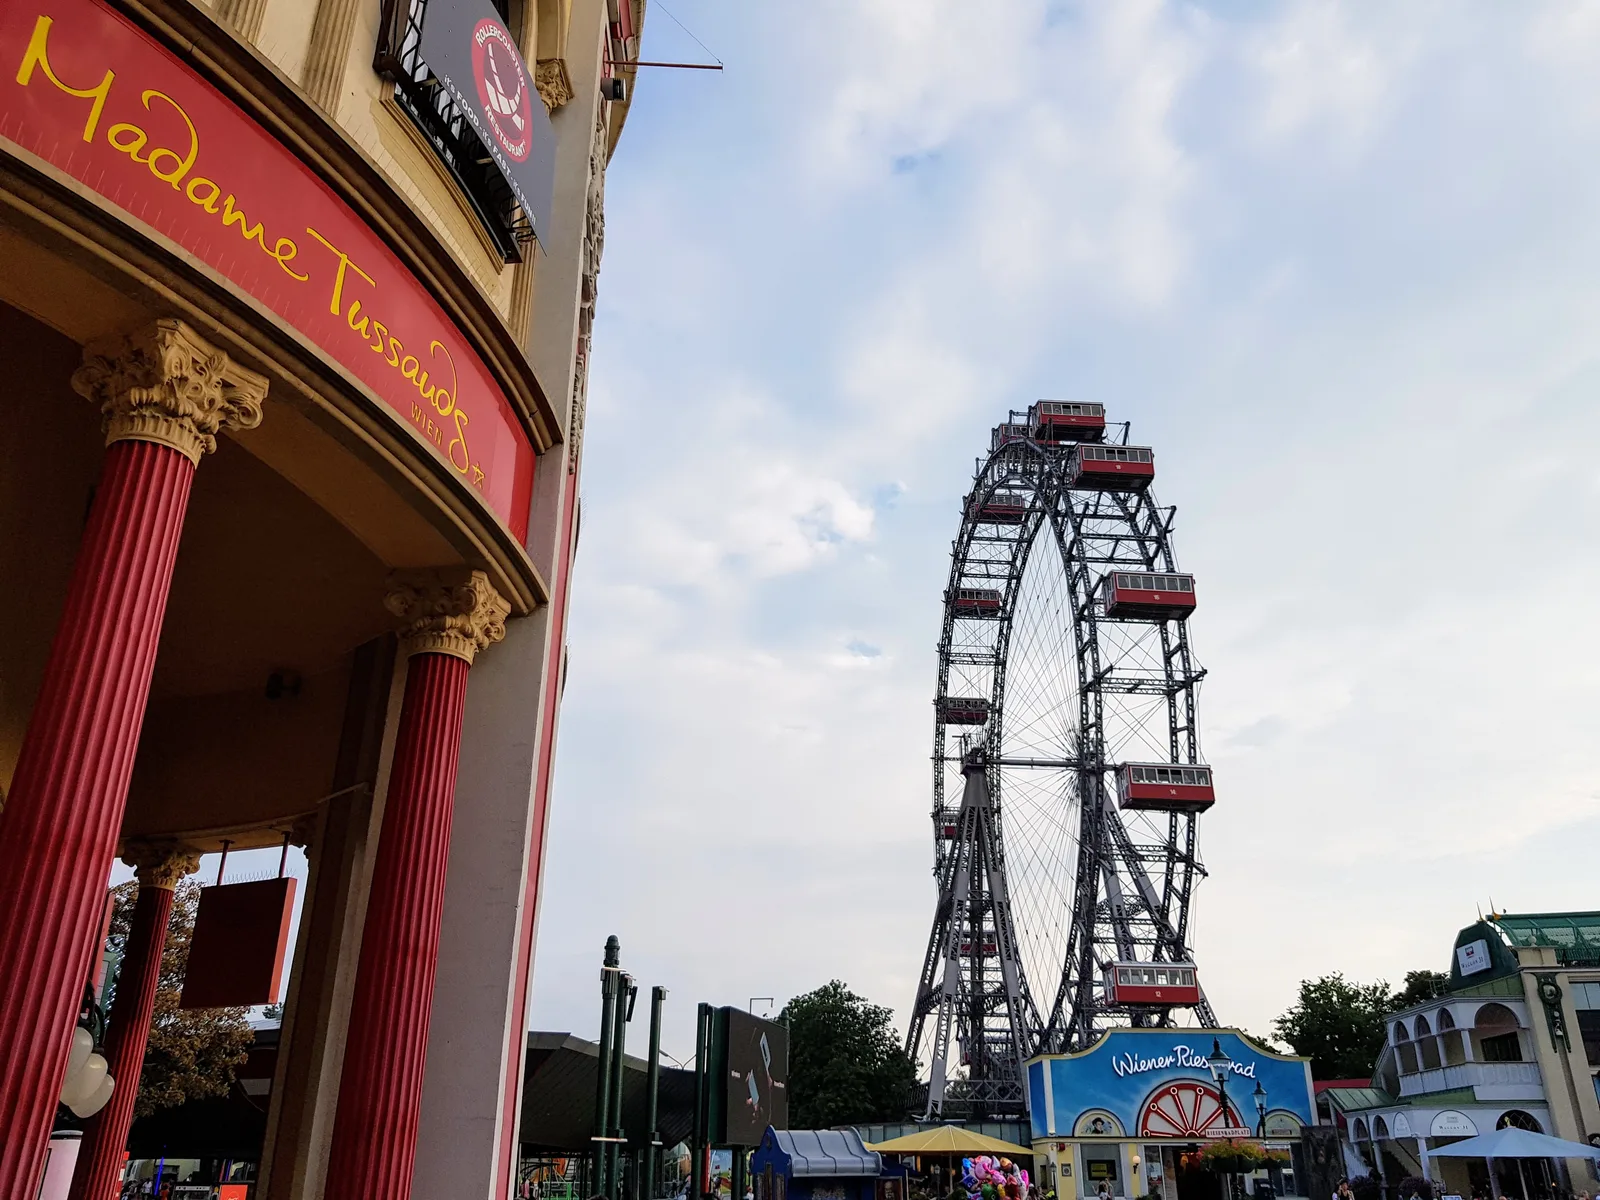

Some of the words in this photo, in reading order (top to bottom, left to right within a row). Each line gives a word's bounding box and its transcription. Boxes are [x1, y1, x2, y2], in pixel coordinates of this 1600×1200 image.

[475, 24, 525, 88] ROLLERCOASTER
[456, 91, 480, 127] FOOD
[492, 145, 512, 176] FAST
[484, 104, 525, 157] RESTAURANT
[16, 15, 309, 281] Madame
[306, 228, 470, 474] Tussauds
[411, 400, 444, 446] WIEN
[1112, 1051, 1176, 1077] Wiener
[1173, 1045, 1256, 1078] Riesrad
